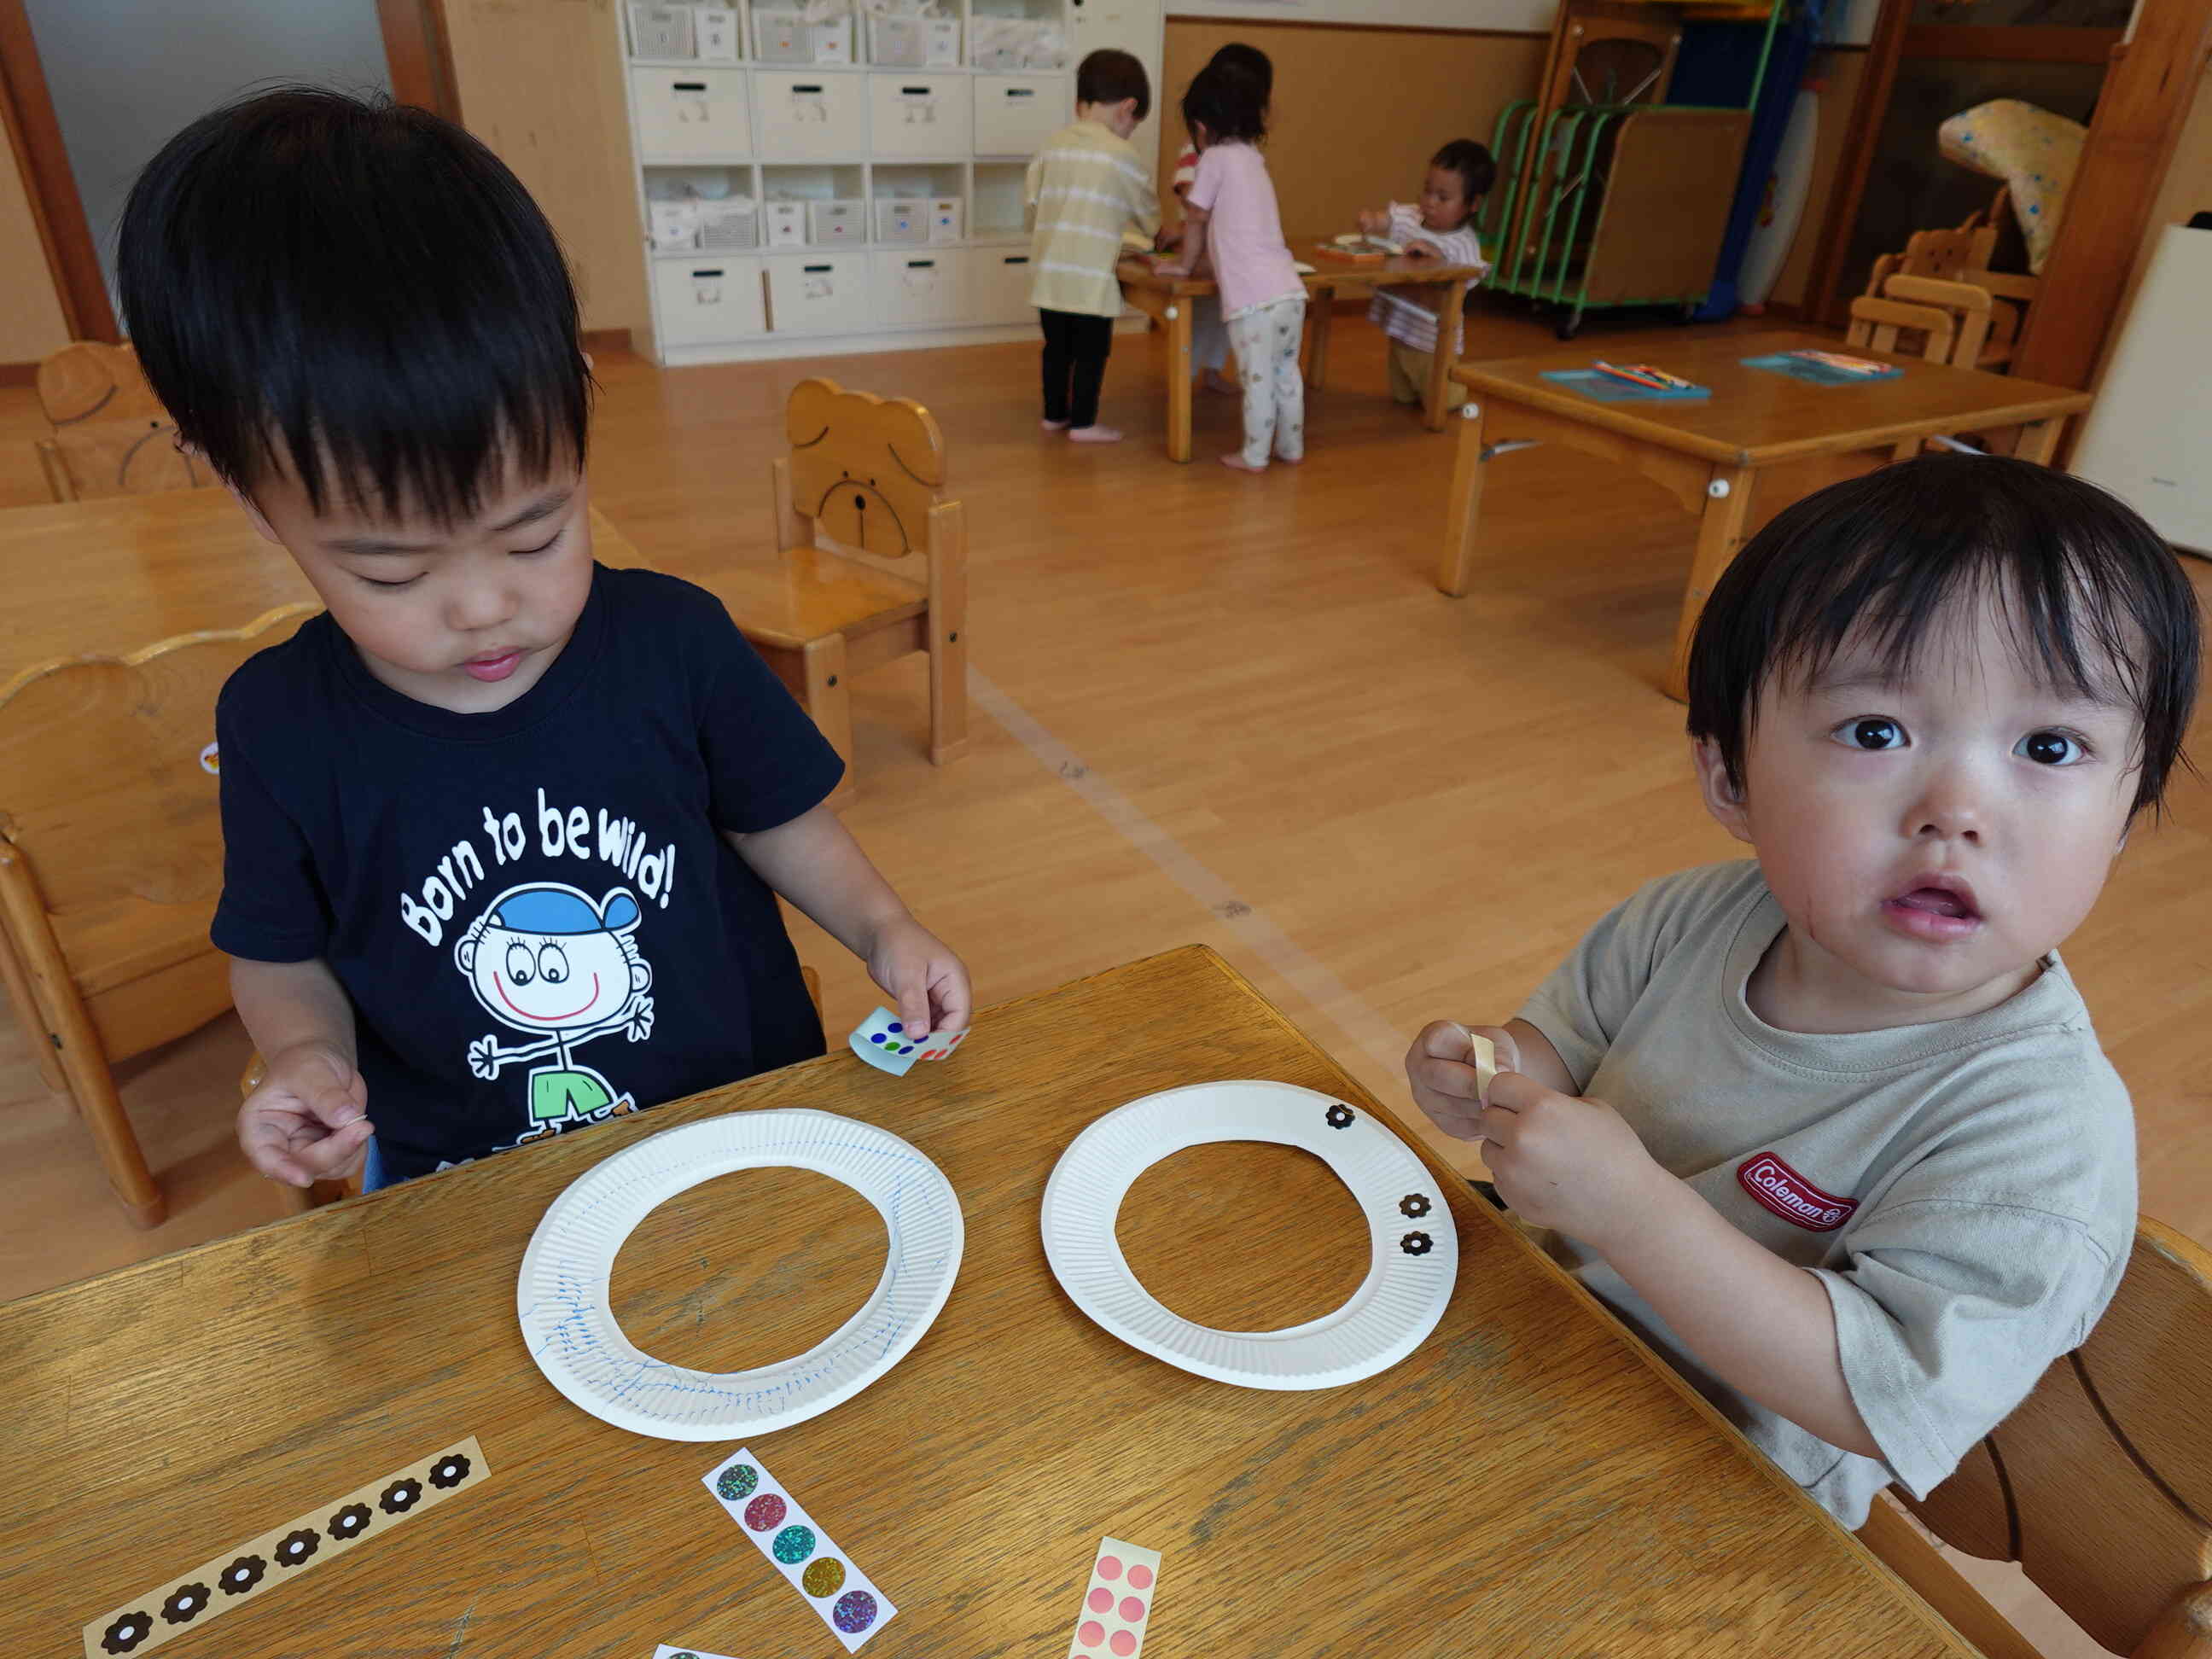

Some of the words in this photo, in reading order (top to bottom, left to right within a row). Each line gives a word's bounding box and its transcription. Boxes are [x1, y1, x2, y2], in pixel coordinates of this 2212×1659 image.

[401, 841, 484, 946] Born
[483, 806, 526, 865] to
[538, 788, 590, 859] be
[1754, 1165, 1824, 1218] Coleman
